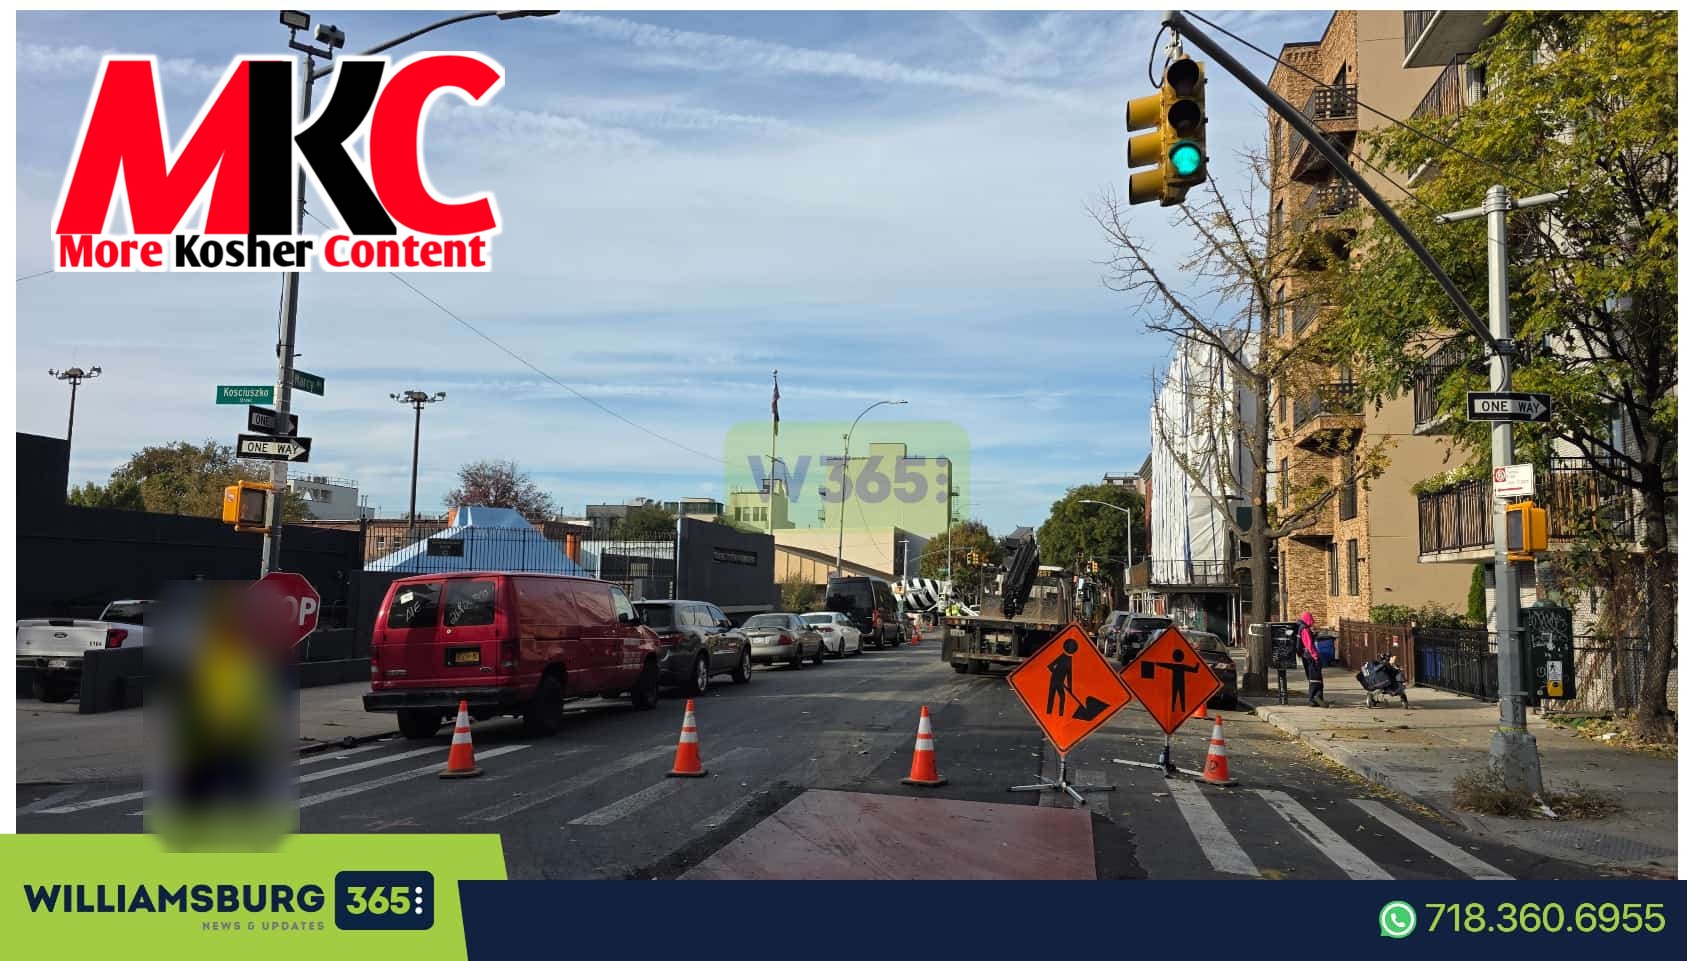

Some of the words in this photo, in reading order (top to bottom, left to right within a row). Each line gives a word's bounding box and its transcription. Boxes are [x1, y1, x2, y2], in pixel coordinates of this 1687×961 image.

[223, 387, 269, 397] Kosciuszko
[1481, 401, 1508, 412] ONE
[1518, 400, 1540, 413] WAY
[247, 442, 268, 453] ONE
[277, 443, 299, 455] WAY
